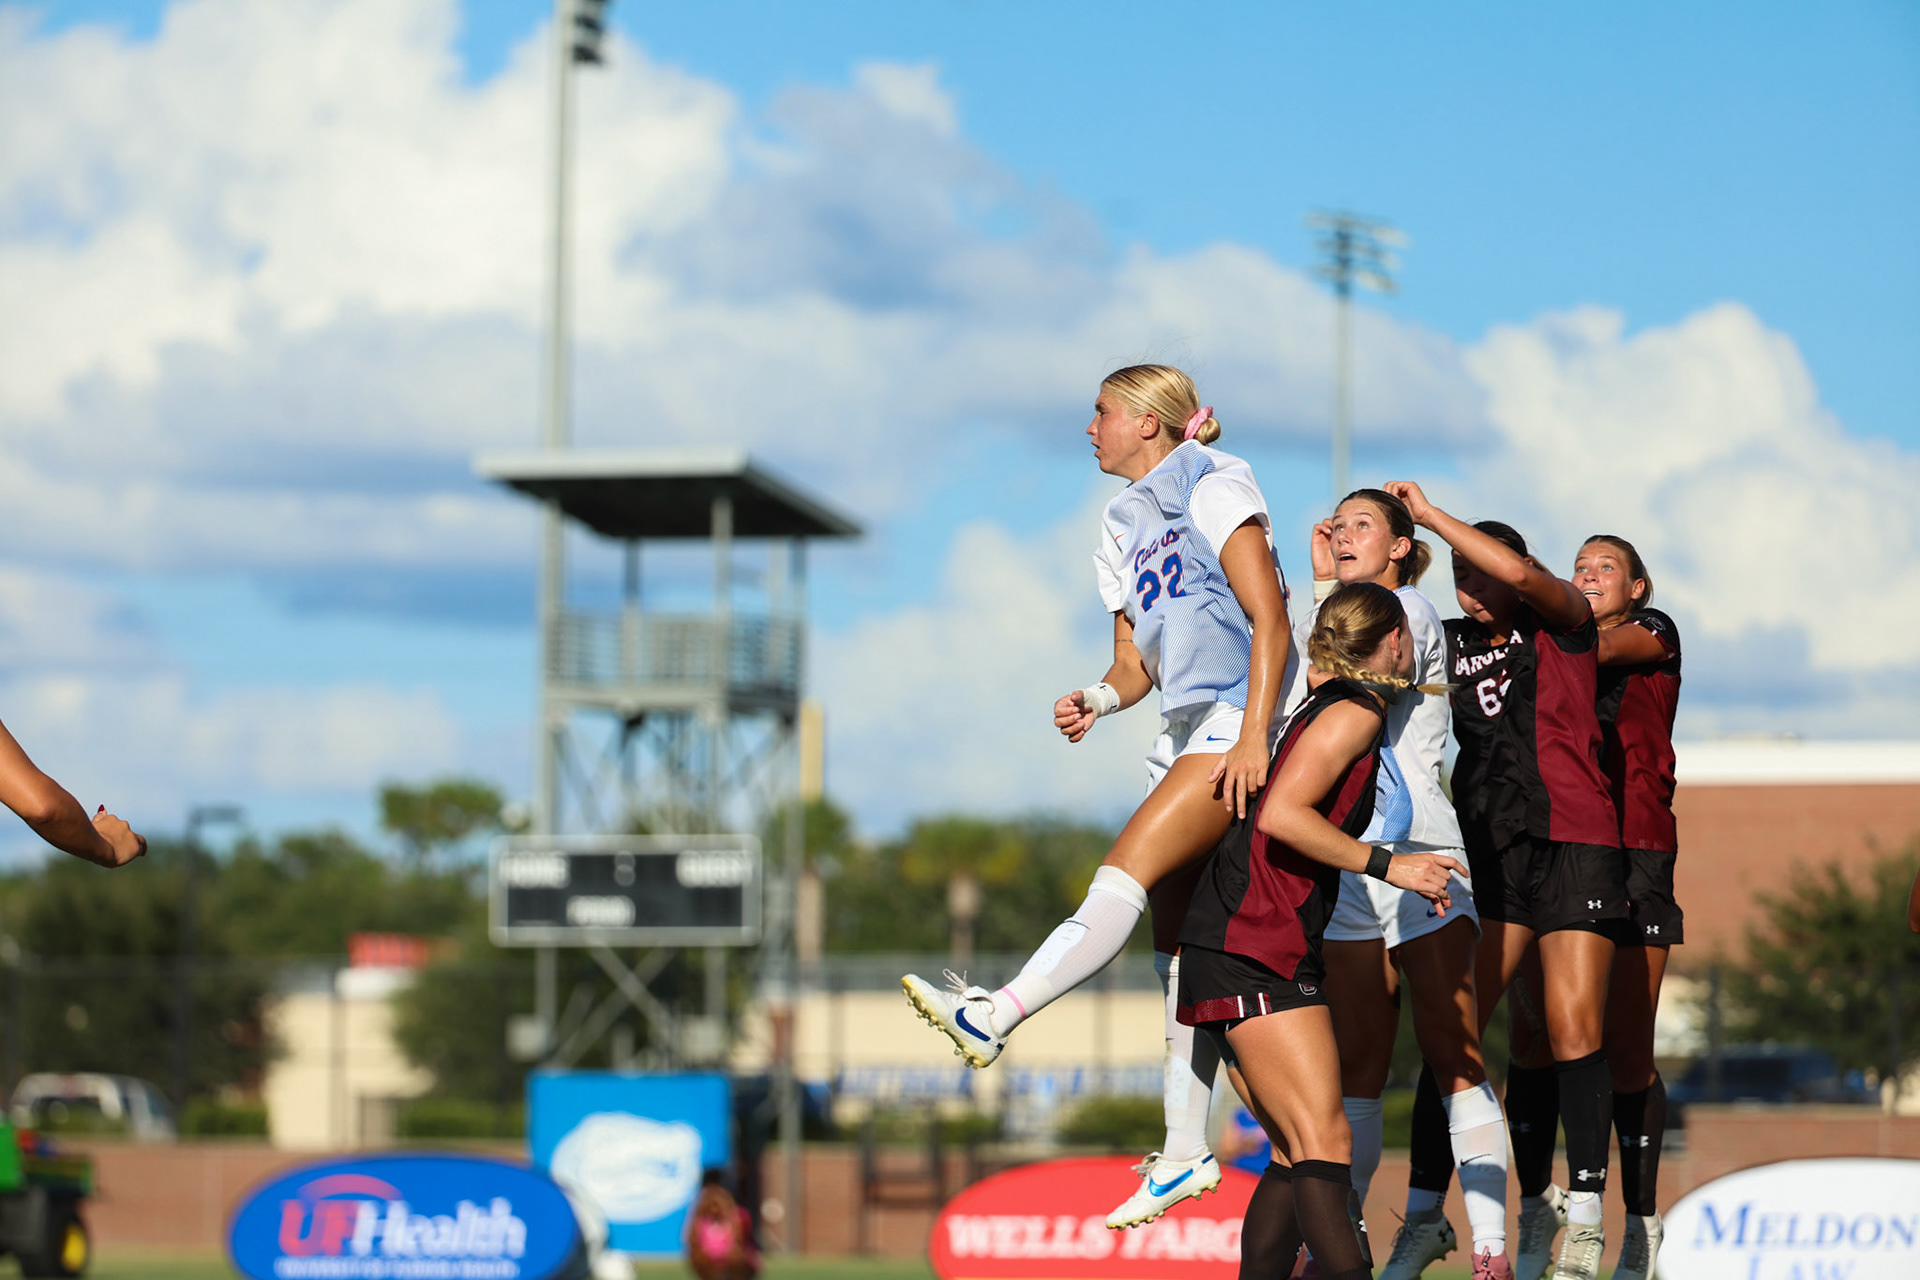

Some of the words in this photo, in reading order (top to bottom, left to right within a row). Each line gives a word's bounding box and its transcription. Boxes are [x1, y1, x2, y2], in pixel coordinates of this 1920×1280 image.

[1136, 551, 1186, 613] 22
[946, 1213, 1117, 1260] WELLS
[1117, 1216, 1242, 1262] FARG
[1690, 1201, 1920, 1250] MELDON
